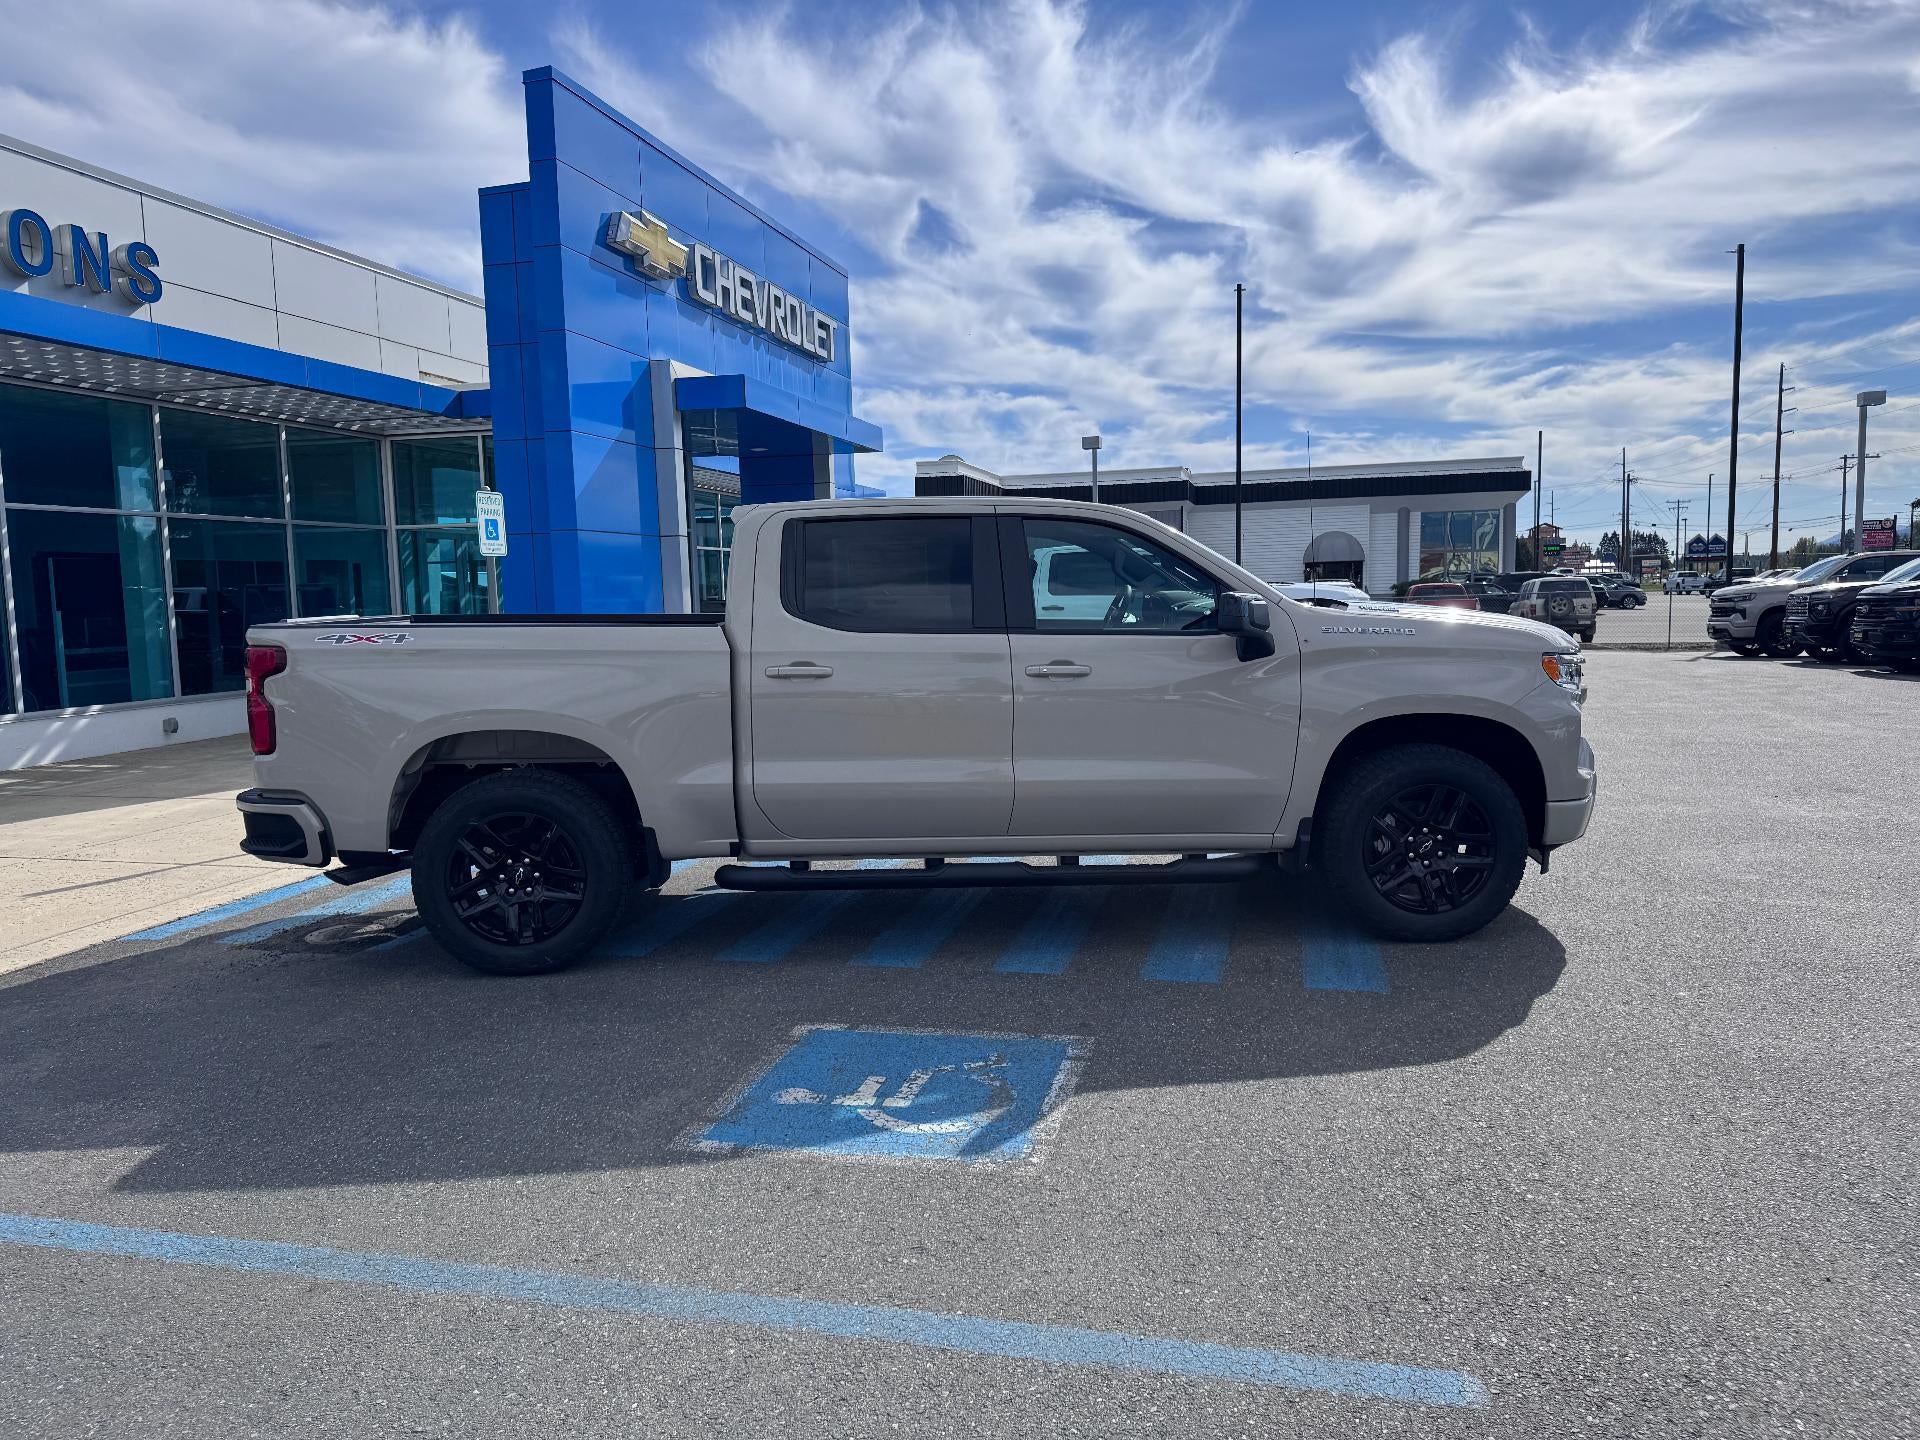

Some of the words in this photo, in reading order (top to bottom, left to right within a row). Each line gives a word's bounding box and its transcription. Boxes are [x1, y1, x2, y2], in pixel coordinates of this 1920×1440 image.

[691, 243, 838, 363] CHEVROLET
[478, 496, 501, 506] RESERVED
[1321, 626, 1416, 636] SILVERADO
